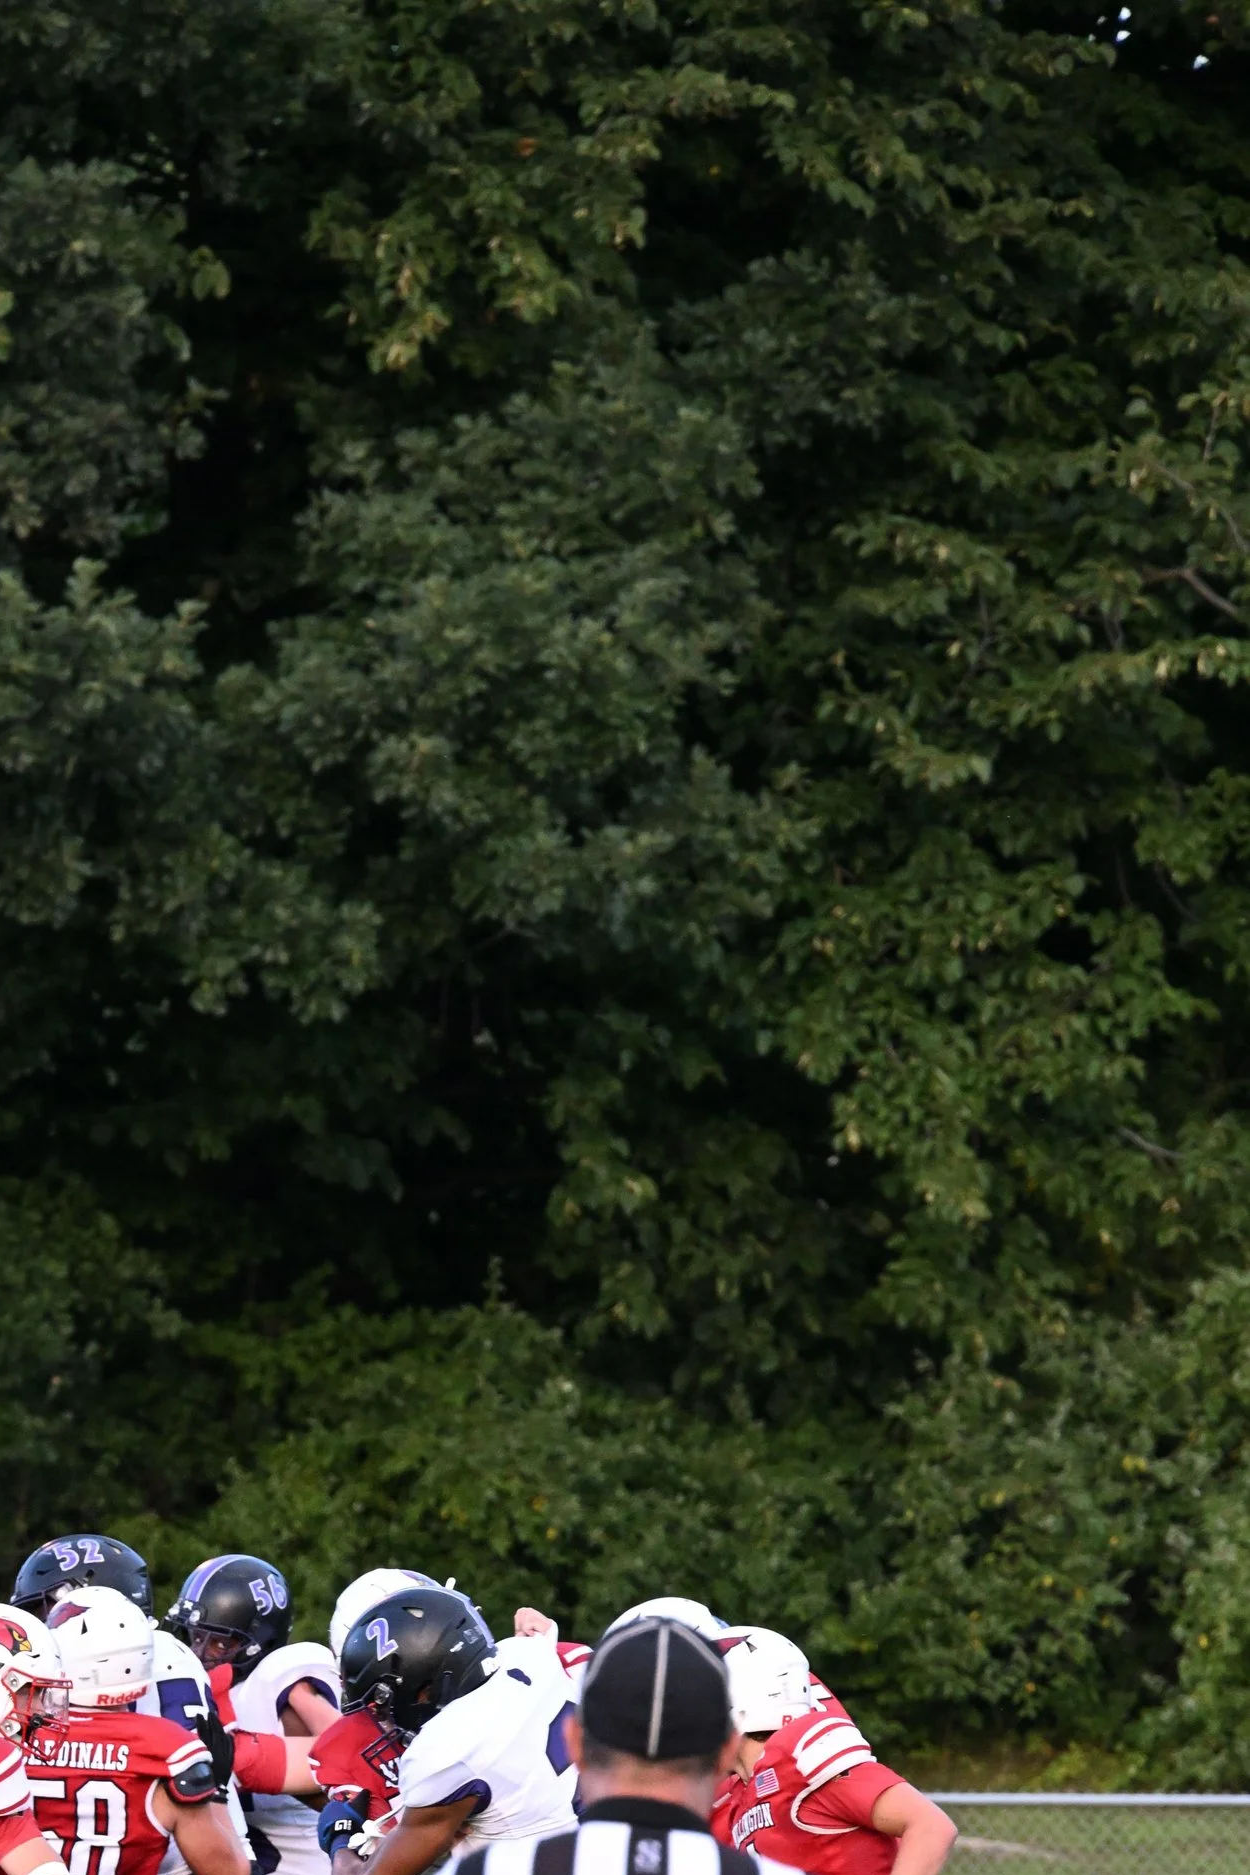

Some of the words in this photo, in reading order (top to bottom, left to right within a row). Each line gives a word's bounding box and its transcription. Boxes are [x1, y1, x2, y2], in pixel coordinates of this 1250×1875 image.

[52, 1538, 106, 1571] 52
[248, 1574, 289, 1616] 56
[366, 1617, 398, 1661] 2
